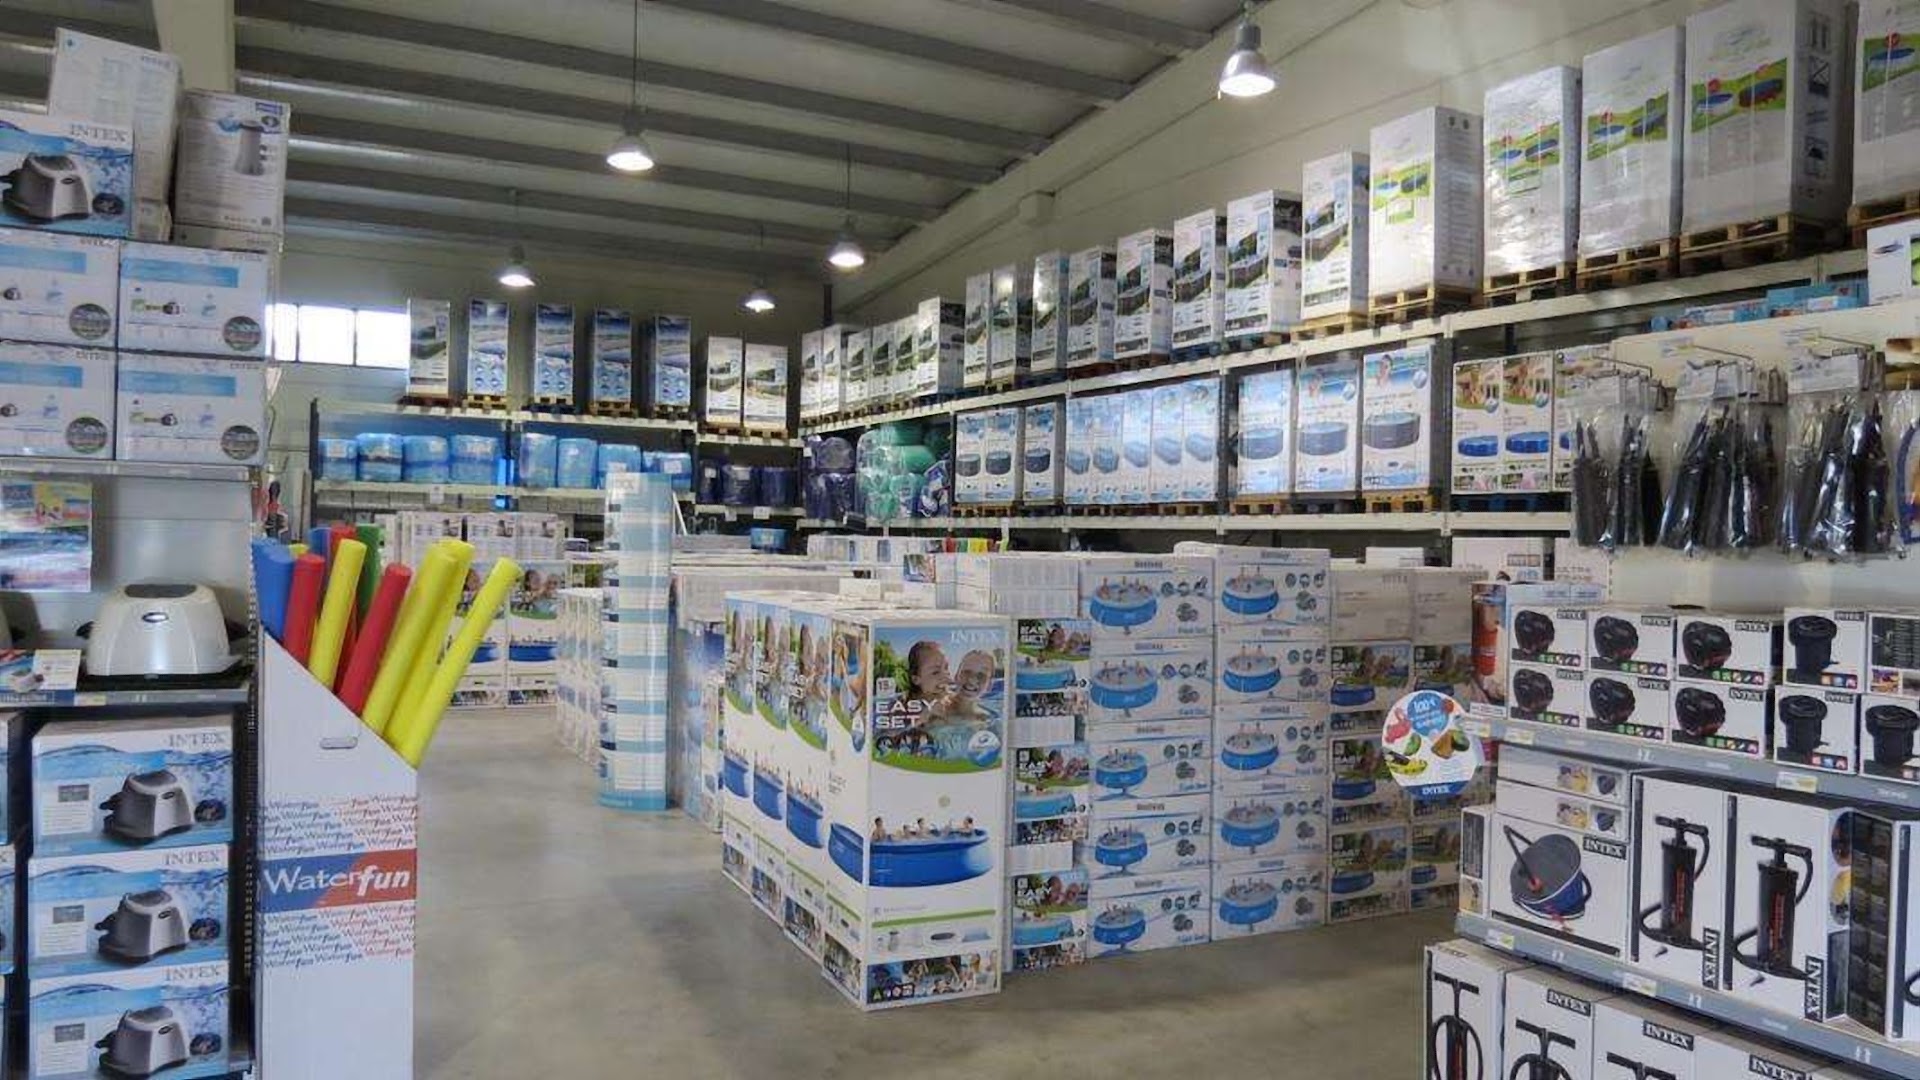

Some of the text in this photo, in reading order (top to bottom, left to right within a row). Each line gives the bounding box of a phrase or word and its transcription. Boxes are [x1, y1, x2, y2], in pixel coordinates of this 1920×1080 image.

[70, 123, 127, 143] INTEX
[952, 630, 1001, 643] INTEX
[875, 699, 938, 714] EASY
[875, 715, 921, 729] SET
[167, 732, 225, 747] INTEX
[163, 849, 219, 865] INTEX
[1585, 836, 1627, 859] INTEX
[263, 864, 411, 897] Waterfun
[1704, 930, 1719, 988] INTEX
[164, 965, 220, 982] INTEX
[1807, 958, 1823, 1022] INTEX
[1548, 990, 1590, 1015] INTEX
[1645, 1020, 1693, 1050] INTEX
